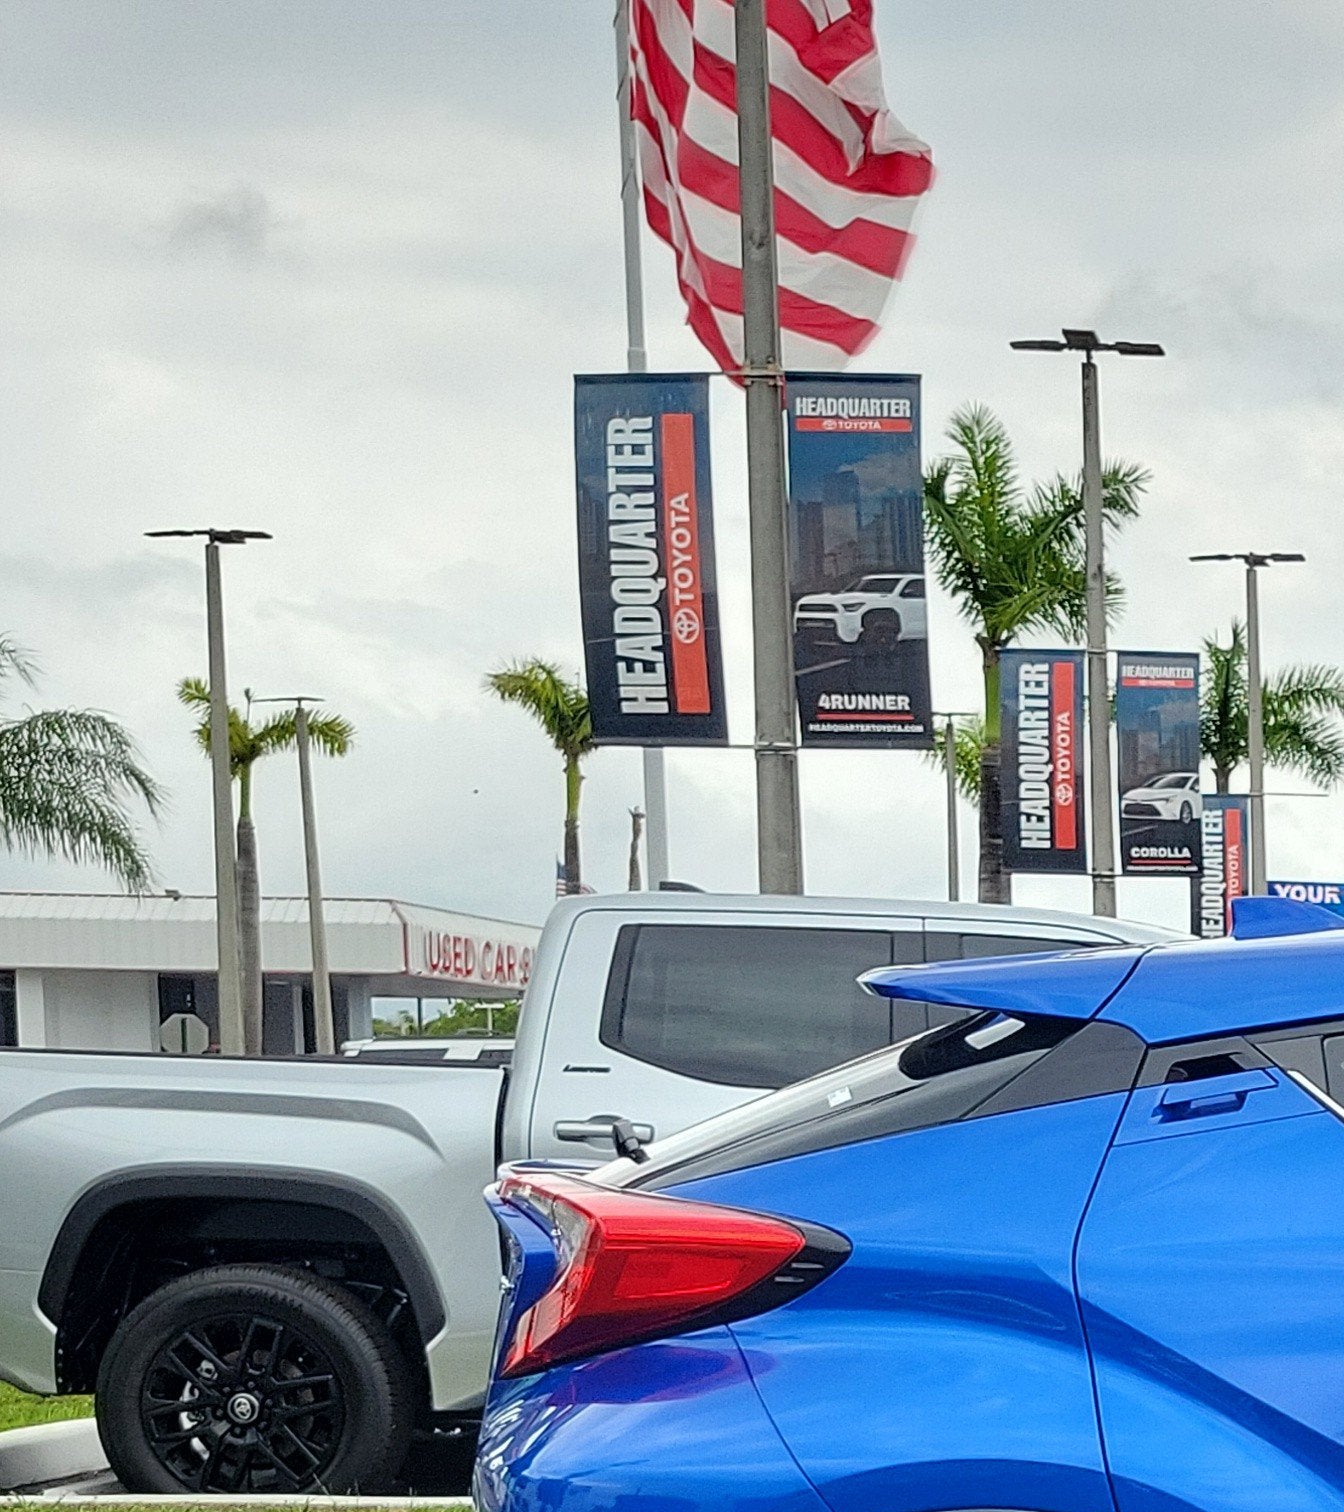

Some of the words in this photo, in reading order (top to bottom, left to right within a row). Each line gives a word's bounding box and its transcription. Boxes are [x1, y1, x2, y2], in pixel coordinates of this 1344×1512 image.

[796, 396, 911, 419] HEADQUARTER
[837, 421, 881, 430] TOYOTA
[607, 415, 669, 714] HEADQUARTER
[669, 492, 695, 606] TOYOTA
[818, 693, 910, 711] 4RUNNER
[1018, 662, 1053, 849] HEADQUARTER
[1055, 711, 1071, 782] TOYOTA
[1130, 846, 1191, 858] COROLLA
[1274, 884, 1341, 904] YOUR
[429, 931, 476, 978] USED
